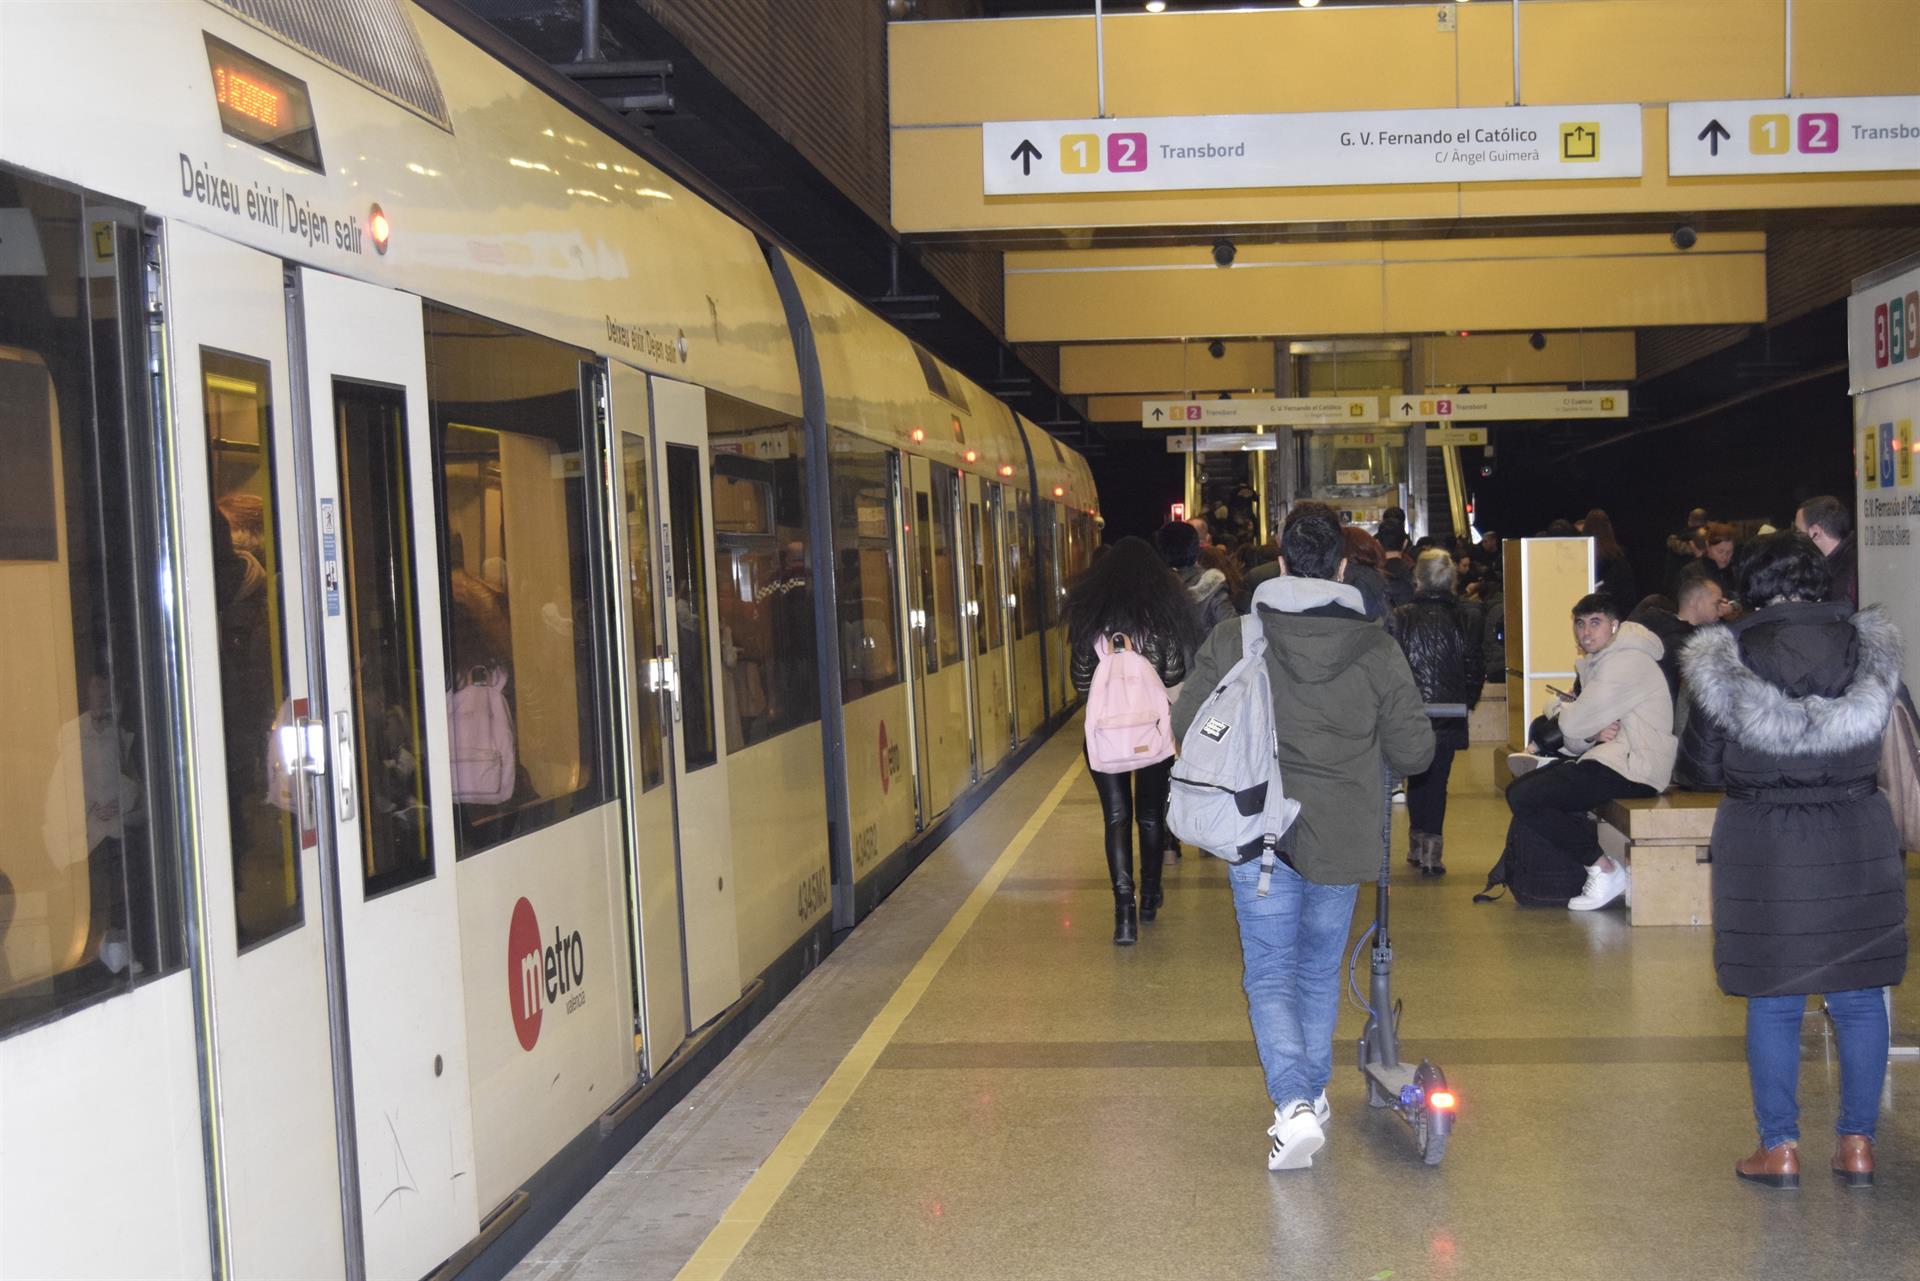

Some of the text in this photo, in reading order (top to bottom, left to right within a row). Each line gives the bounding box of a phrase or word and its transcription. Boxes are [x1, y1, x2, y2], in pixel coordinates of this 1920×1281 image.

[1340, 127, 1537, 146] G. V. Fernando el Católico
[1761, 121, 1780, 149] 1
[1808, 119, 1828, 148] 2
[1071, 138, 1245, 167] 1 2 Transbord
[1435, 148, 1540, 166] C/ Àngel Guimerà
[179, 153, 240, 214] Deixeu
[335, 215, 363, 255] salir
[605, 314, 630, 348] Deixeu
[1878, 303, 1917, 359] 3 5 9
[1190, 407, 1198, 419] 2
[1440, 402, 1448, 413] 2
[521, 926, 584, 1020] metro
